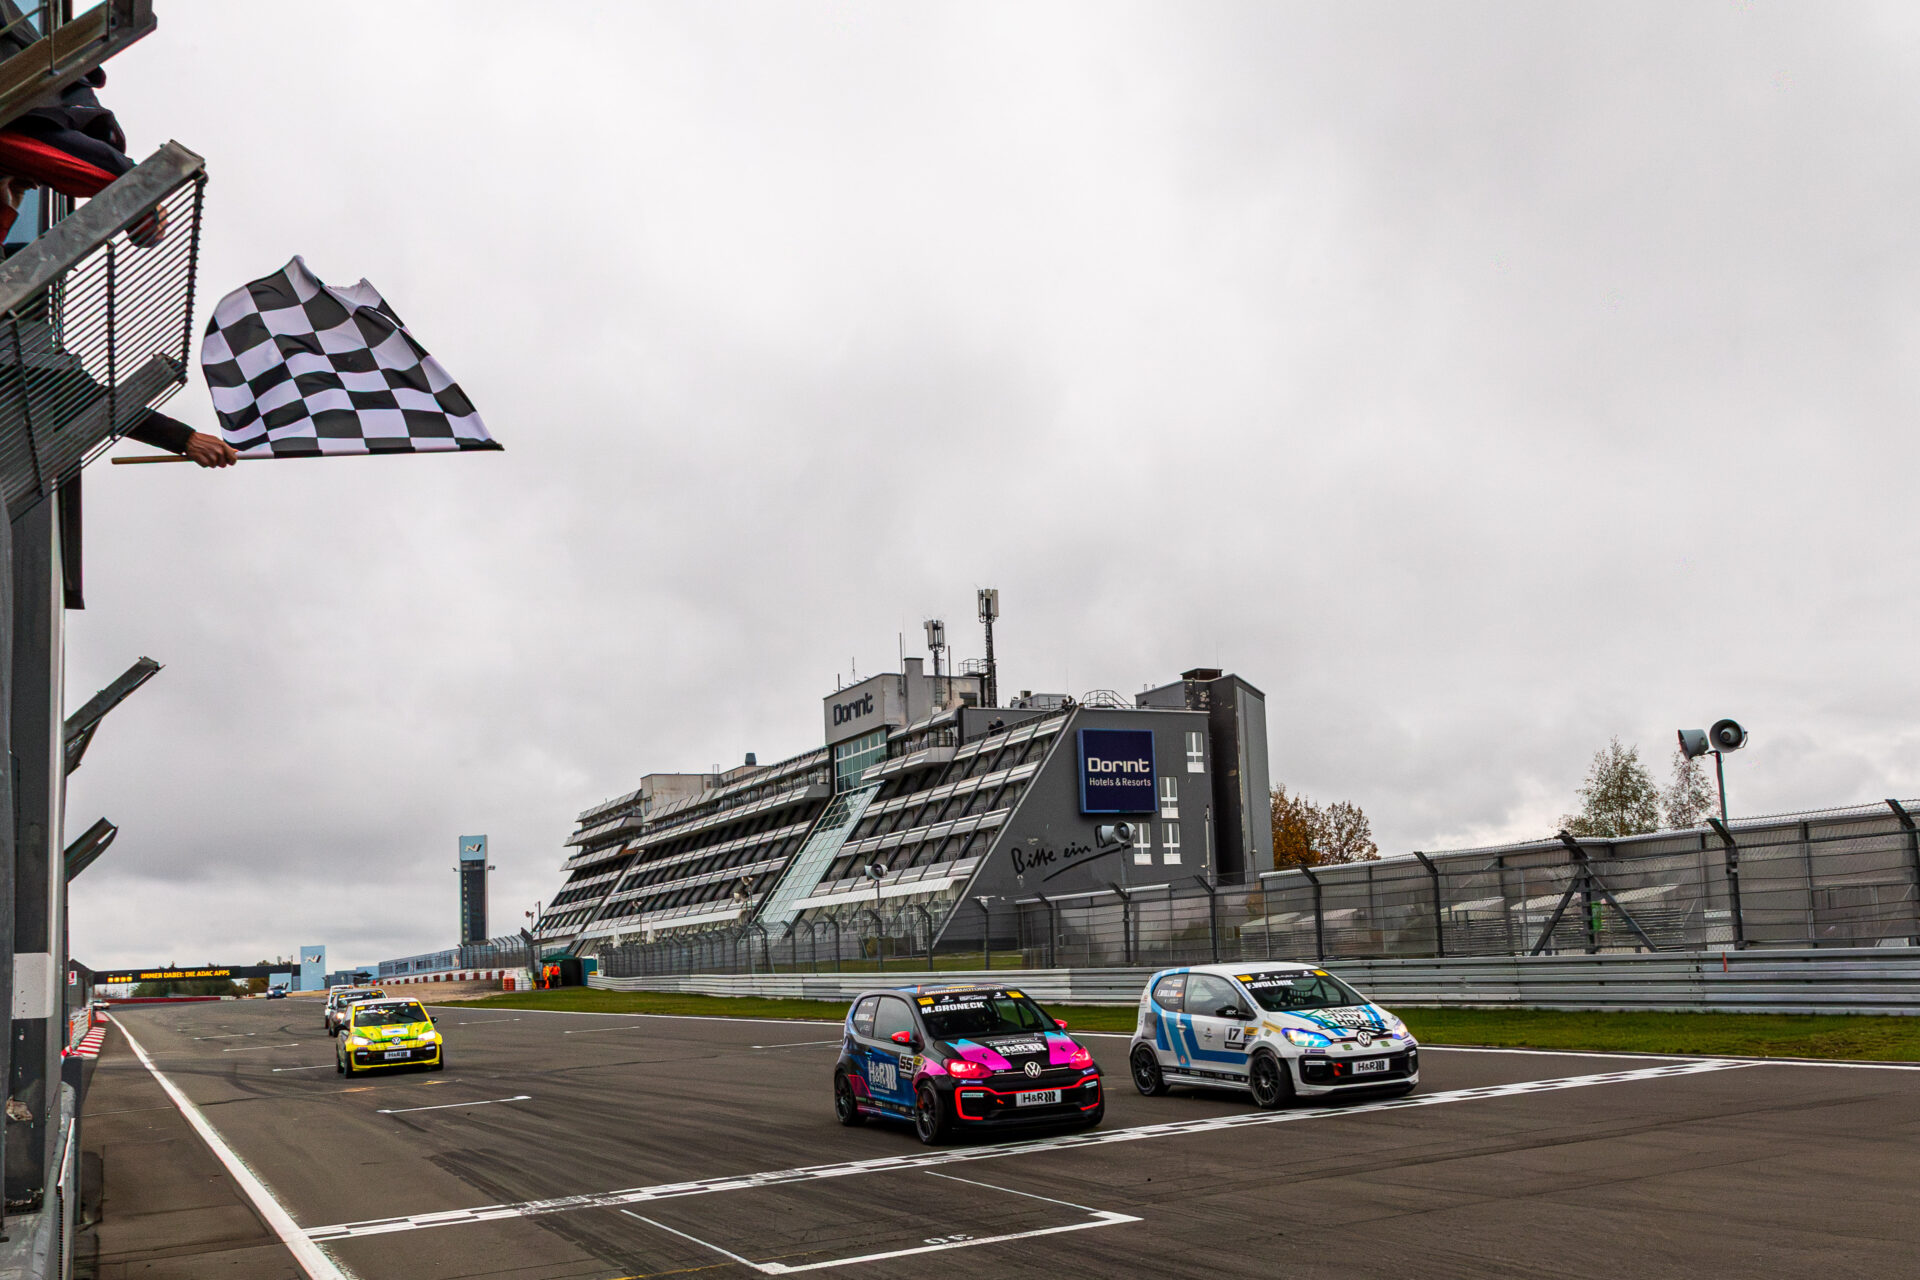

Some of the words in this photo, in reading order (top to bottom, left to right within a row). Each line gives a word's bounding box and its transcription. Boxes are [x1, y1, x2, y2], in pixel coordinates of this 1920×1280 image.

[833, 692, 873, 726] Dorint
[1088, 757, 1150, 772] Dorint
[1090, 777, 1114, 786] Hotels
[1115, 777, 1121, 786] &
[1122, 777, 1152, 787] Resorts
[1011, 847, 1056, 875] Bitte
[1063, 842, 1091, 858] ein
[921, 1002, 985, 1014] M.GRONECK
[1228, 1027, 1241, 1040] 17
[900, 1055, 913, 1071] 55
[1022, 1091, 1046, 1103] H&R
